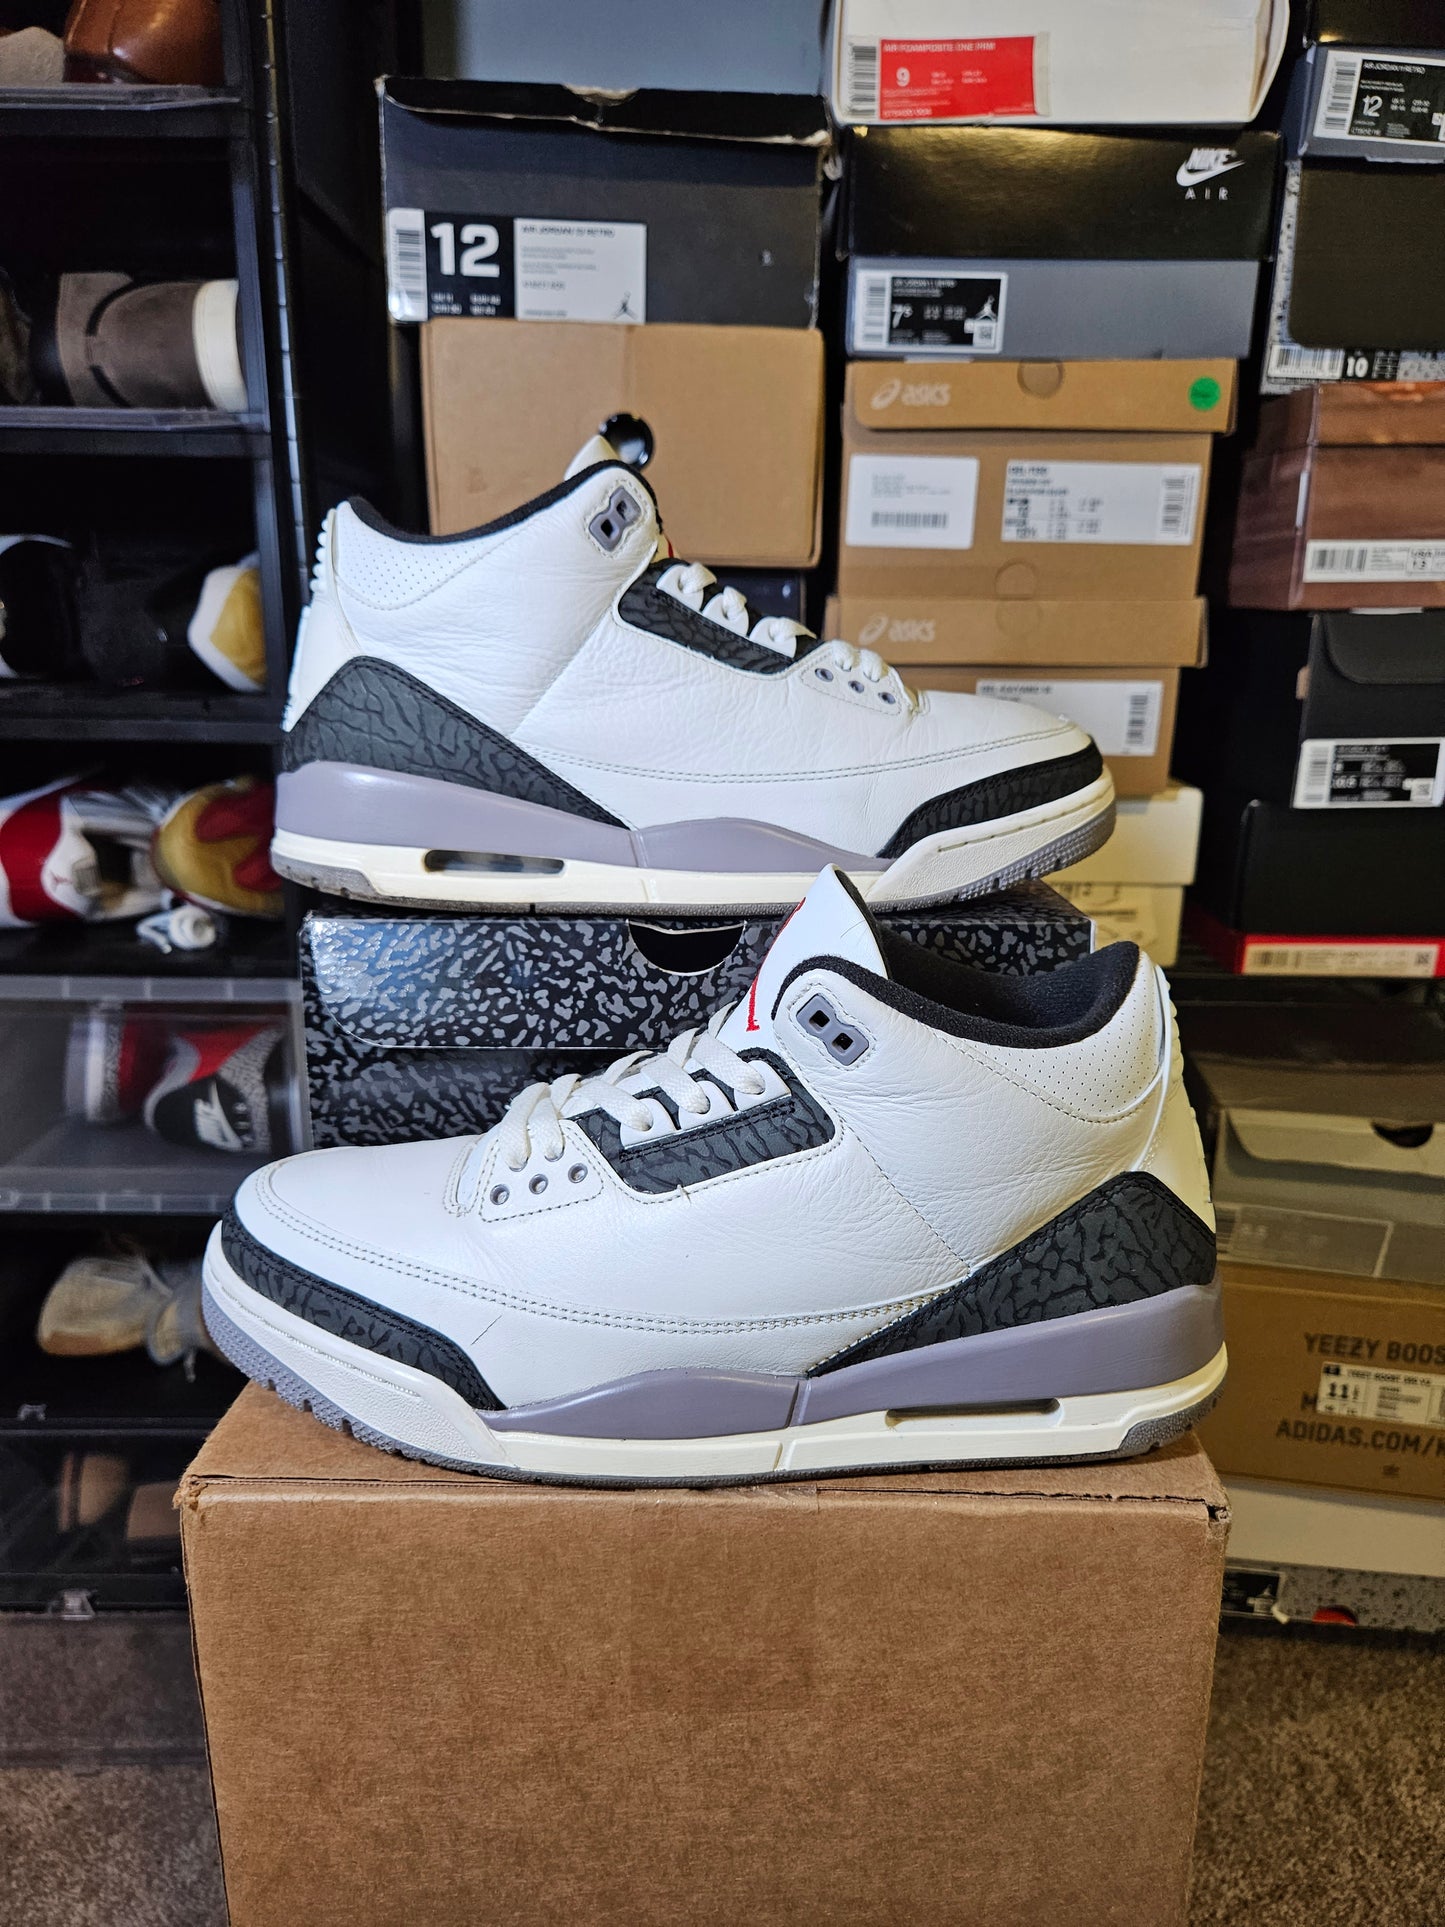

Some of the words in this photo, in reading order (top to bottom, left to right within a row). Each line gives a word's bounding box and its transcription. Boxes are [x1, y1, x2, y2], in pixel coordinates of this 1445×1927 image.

[896, 67, 911, 87] 9
[1362, 94, 1384, 118] 12
[1186, 147, 1231, 170] NIKE
[1185, 186, 1229, 200] AIR
[430, 222, 500, 278] 12
[1346, 356, 1369, 378] 10
[1304, 1332, 1380, 1361] YEEZY
